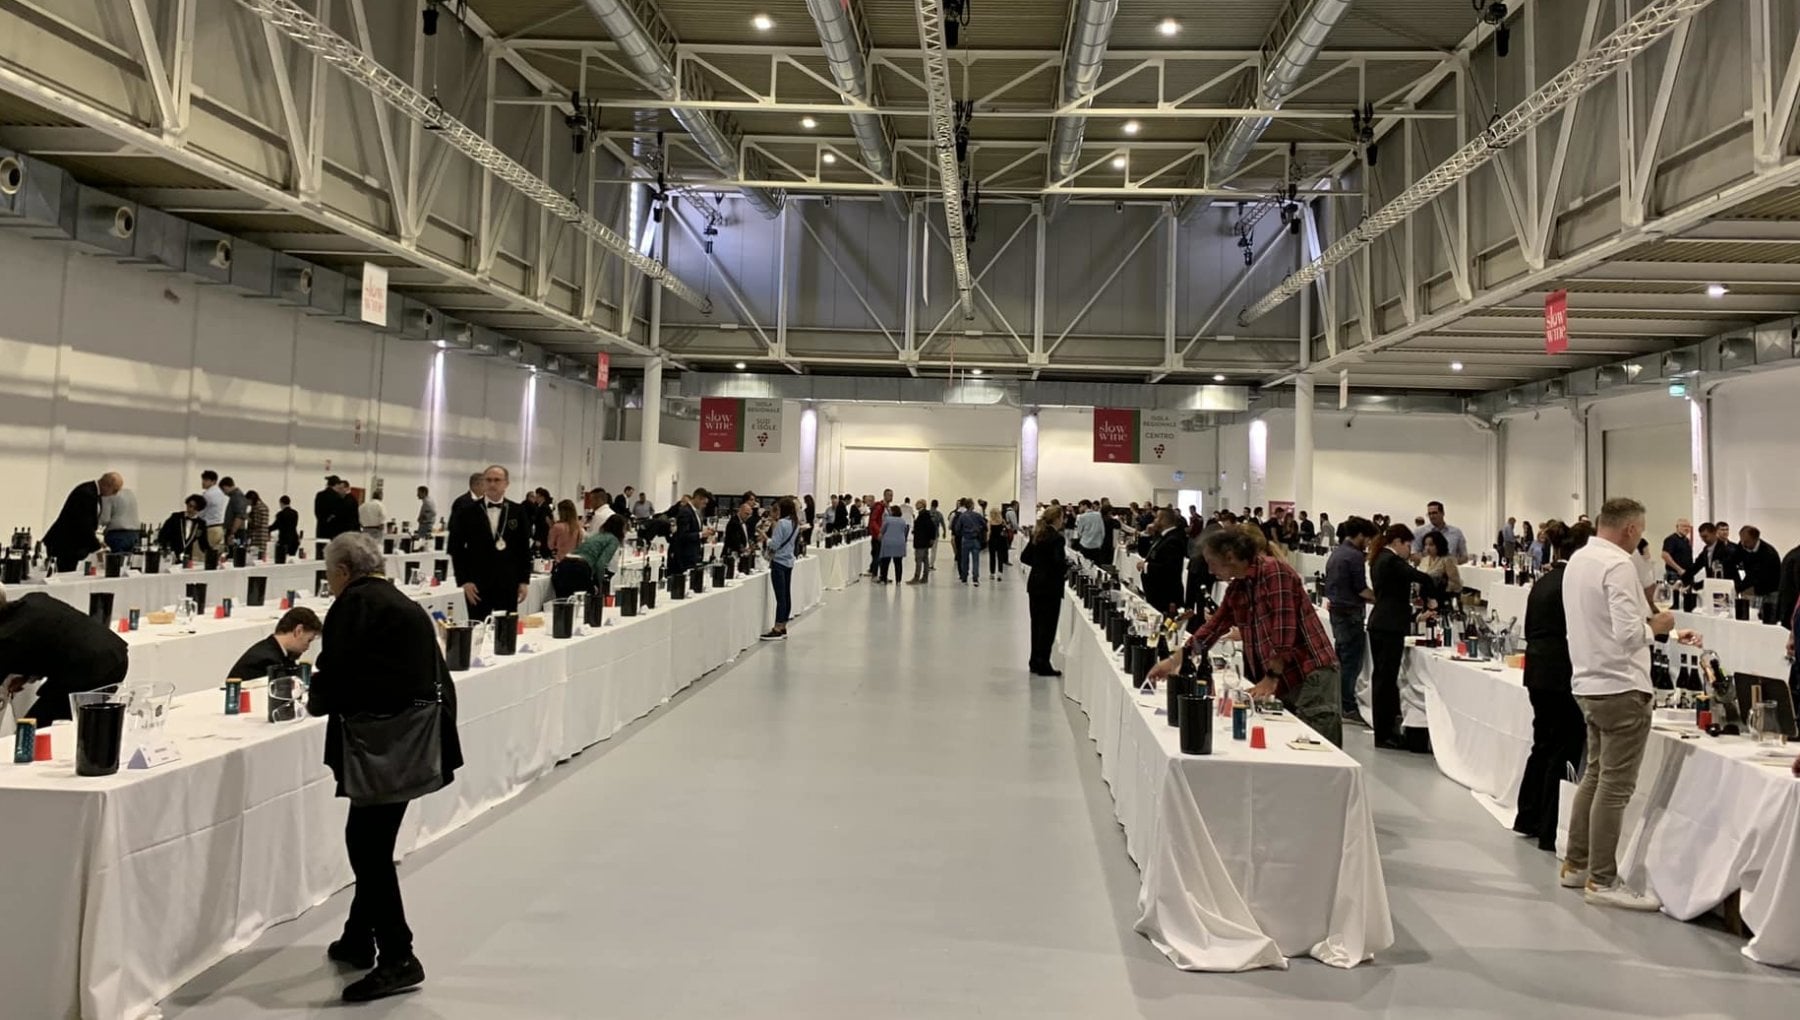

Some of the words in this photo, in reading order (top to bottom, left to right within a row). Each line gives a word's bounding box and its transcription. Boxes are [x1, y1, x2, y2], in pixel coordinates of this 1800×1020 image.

[705, 409, 732, 422] slow
[705, 422, 734, 430] wine
[1099, 420, 1127, 433] slow
[1099, 432, 1128, 441] wine
